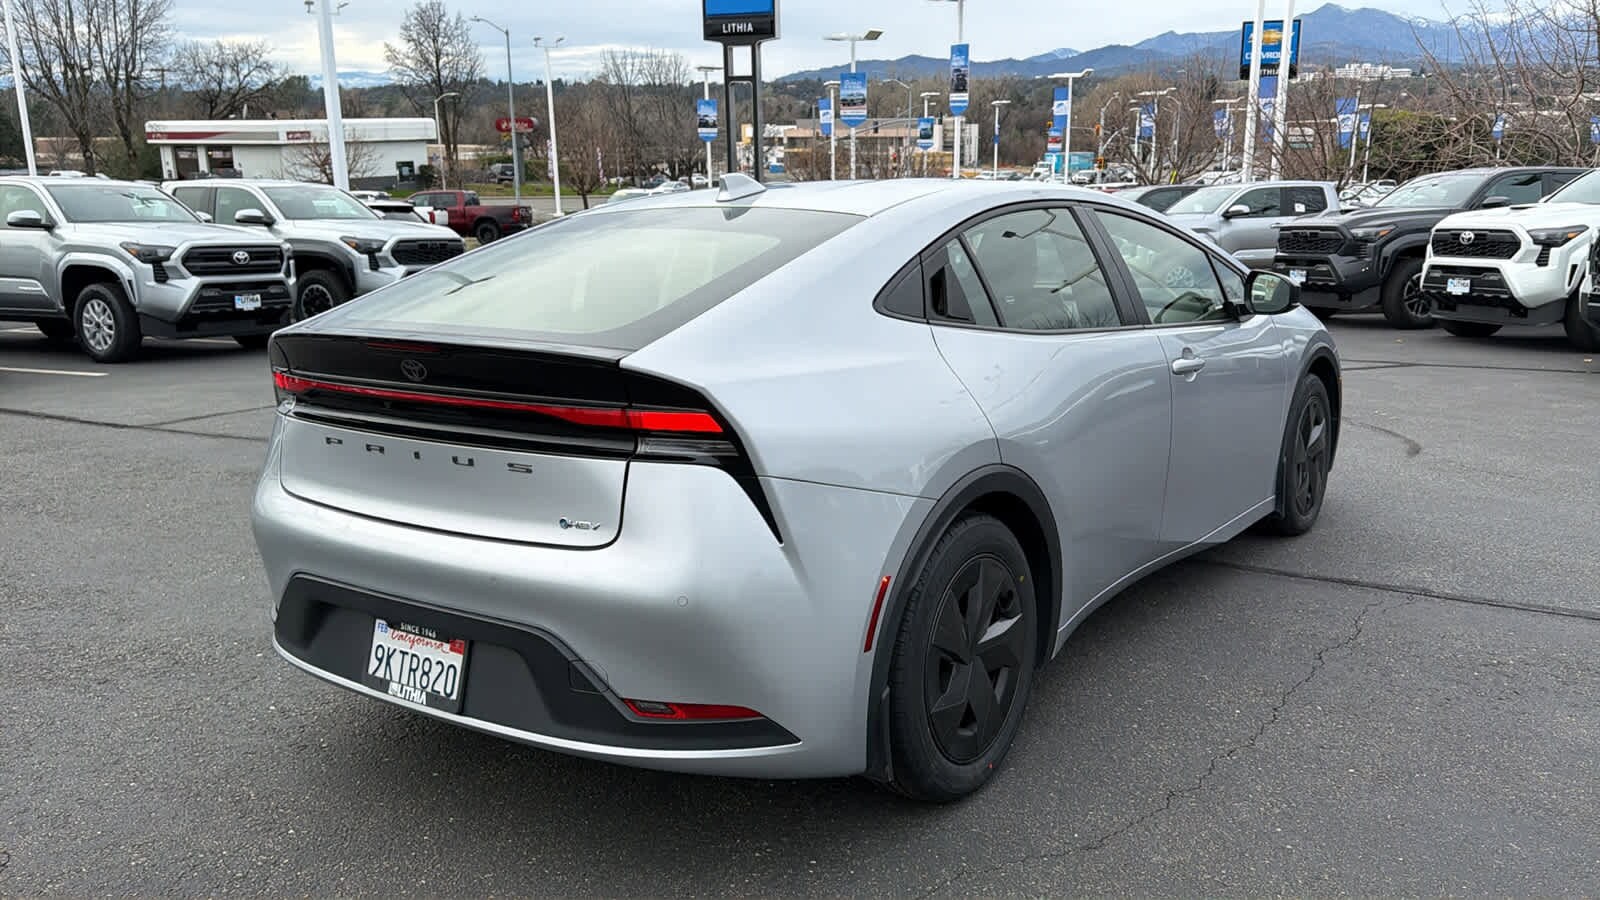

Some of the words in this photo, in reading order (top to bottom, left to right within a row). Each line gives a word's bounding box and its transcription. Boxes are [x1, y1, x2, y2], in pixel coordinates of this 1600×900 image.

[722, 22, 754, 33] LITHIA
[326, 437, 533, 474] PRIUS
[377, 622, 389, 633] FEB
[400, 622, 420, 633] SINCE
[372, 644, 457, 698] 9KTR820
[397, 683, 427, 705] LITHIA
